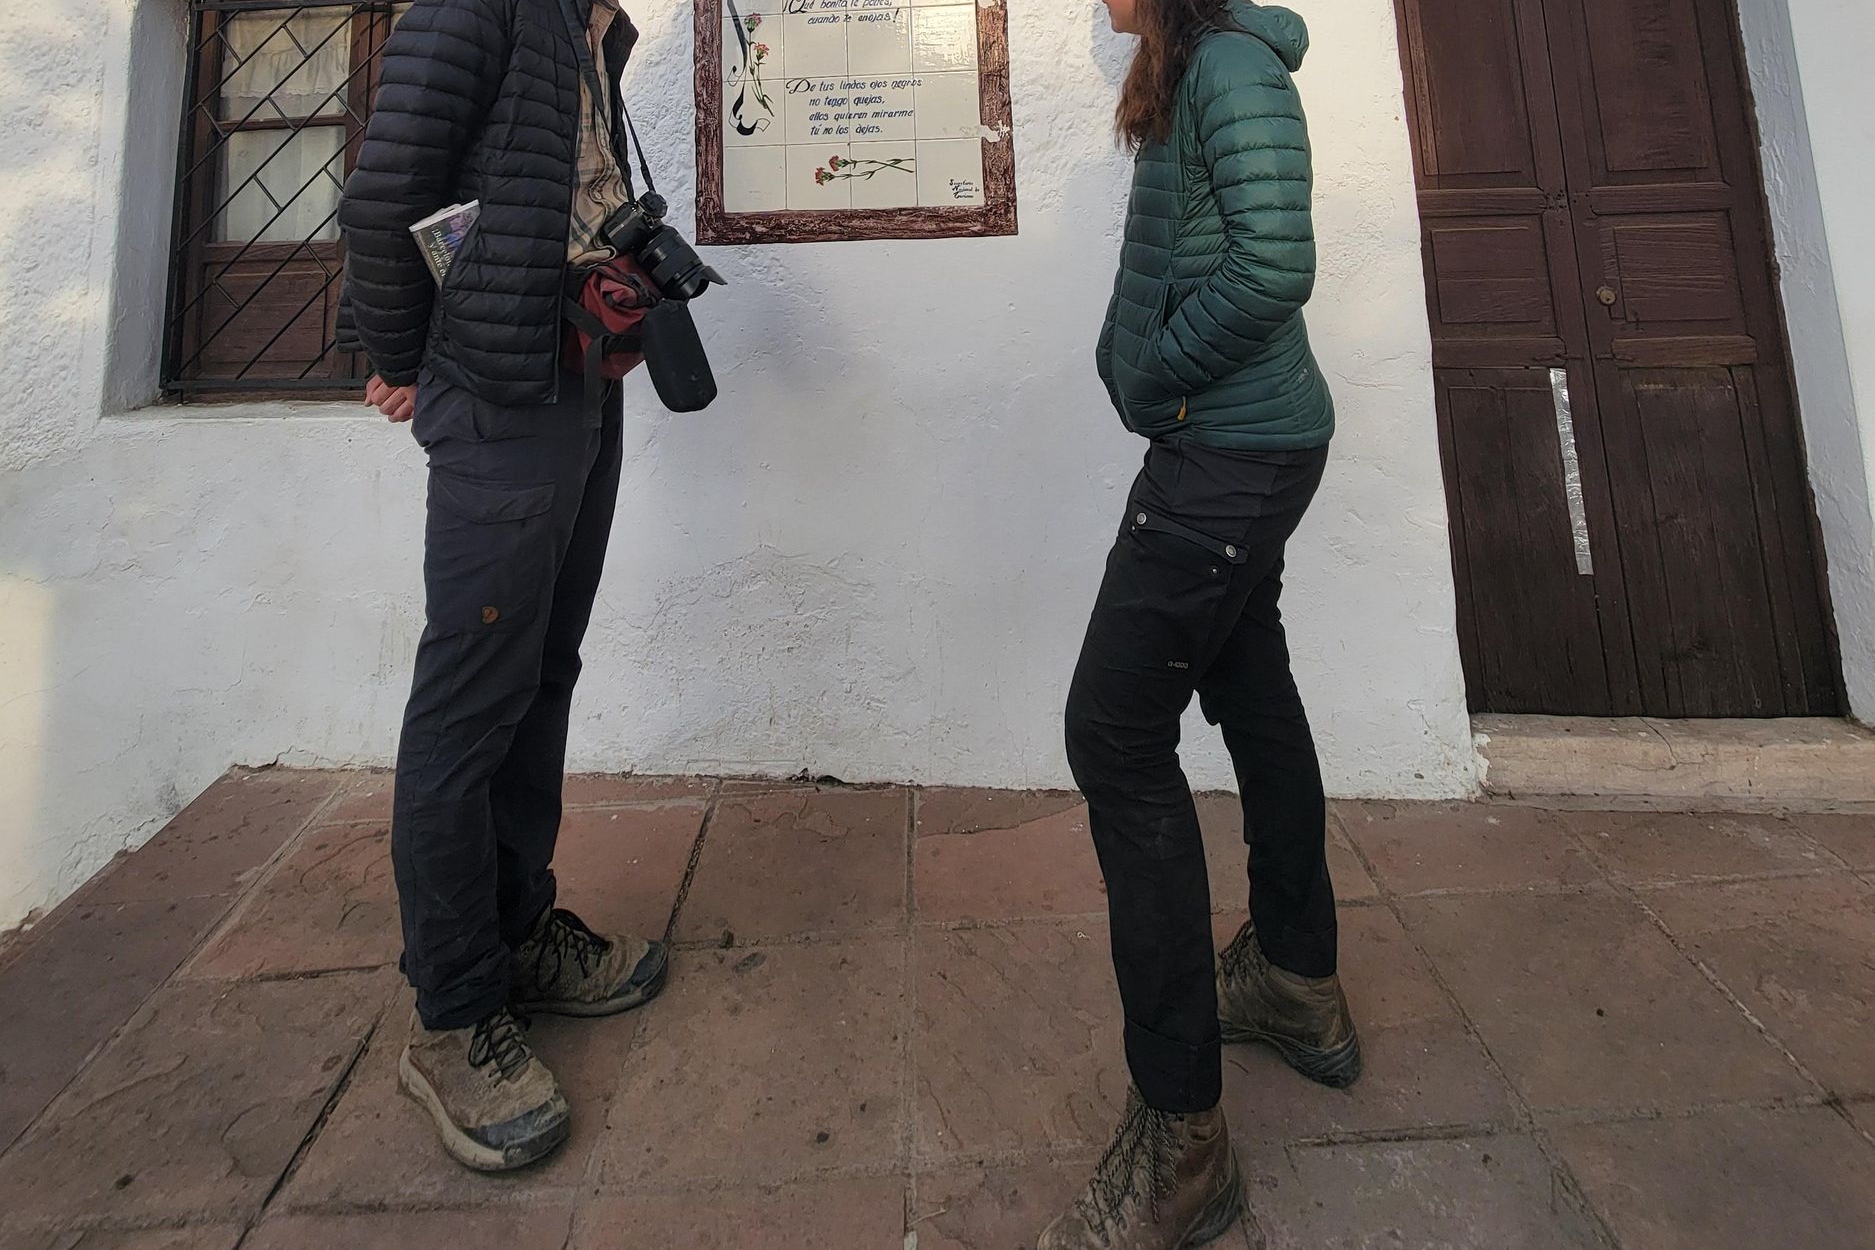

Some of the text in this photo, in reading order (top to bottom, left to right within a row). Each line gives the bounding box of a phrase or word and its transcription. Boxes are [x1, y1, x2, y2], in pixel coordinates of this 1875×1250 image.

[820, 0, 848, 9] bonita
[808, 14, 840, 24] cuando
[843, 13, 851, 23] te
[785, 78, 923, 94] De tus lindos ojos negros
[809, 94, 885, 108] no tengo quejas,
[809, 110, 914, 122] ellos quieren mirarme
[810, 124, 883, 135] tú no los dejas.
